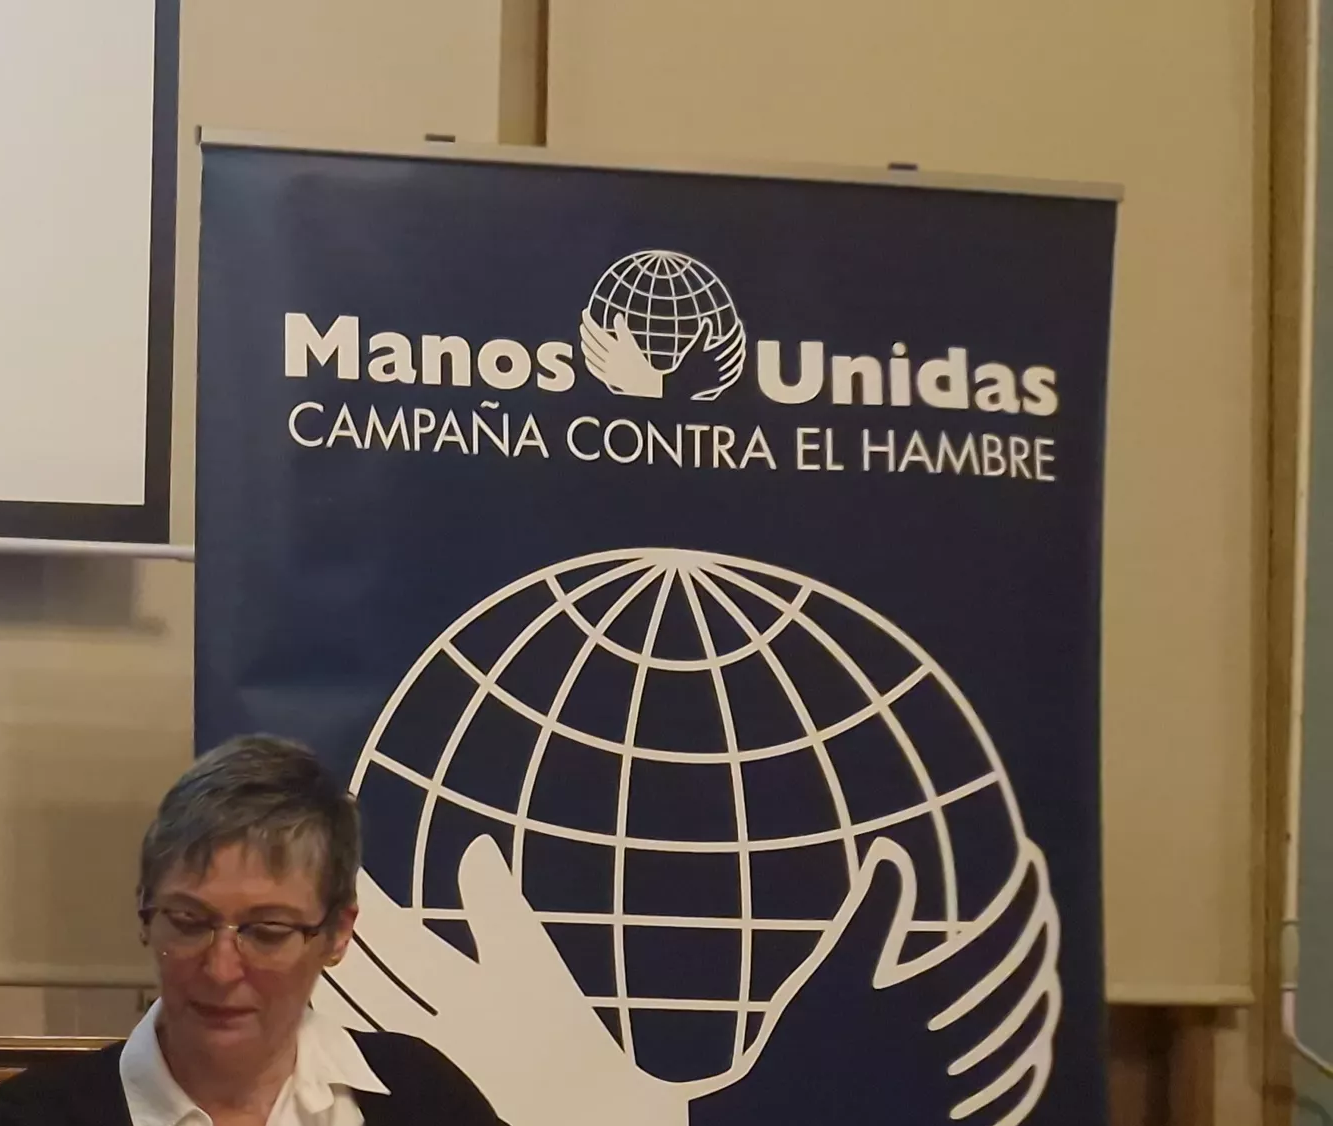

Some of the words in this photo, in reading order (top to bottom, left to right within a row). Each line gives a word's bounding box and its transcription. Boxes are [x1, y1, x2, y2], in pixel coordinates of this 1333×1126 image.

[284, 312, 576, 393] Manos
[756, 340, 1059, 417] Unidas
[287, 400, 550, 460] CAMPAÑA
[566, 416, 777, 471] CONTRA
[796, 429, 844, 472] EL
[862, 431, 1056, 482] HAMBRE
